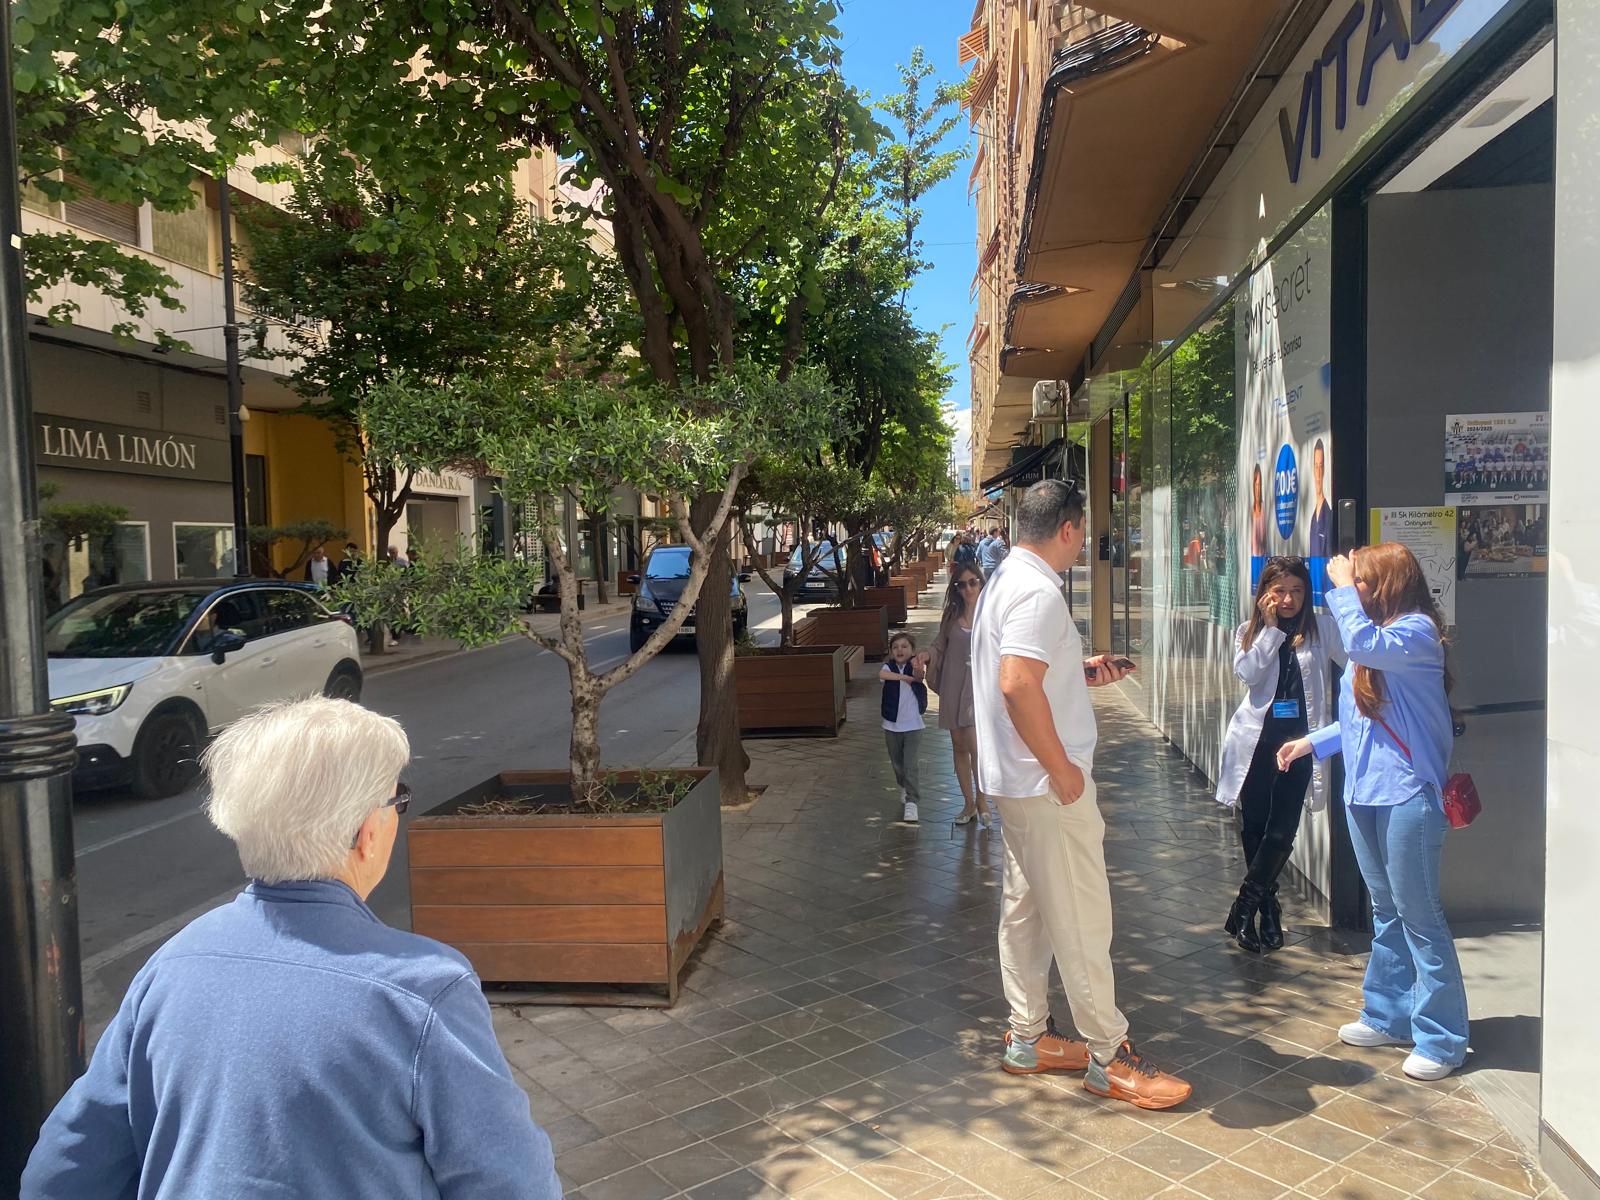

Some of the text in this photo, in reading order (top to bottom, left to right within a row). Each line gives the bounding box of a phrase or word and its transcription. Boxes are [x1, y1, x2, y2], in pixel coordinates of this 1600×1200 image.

[41, 425, 197, 470] LIMA LIMÓN
[415, 472, 462, 491] DANDARA
[1275, 467, 1297, 498] 200€
[1444, 509, 1455, 518] 42
